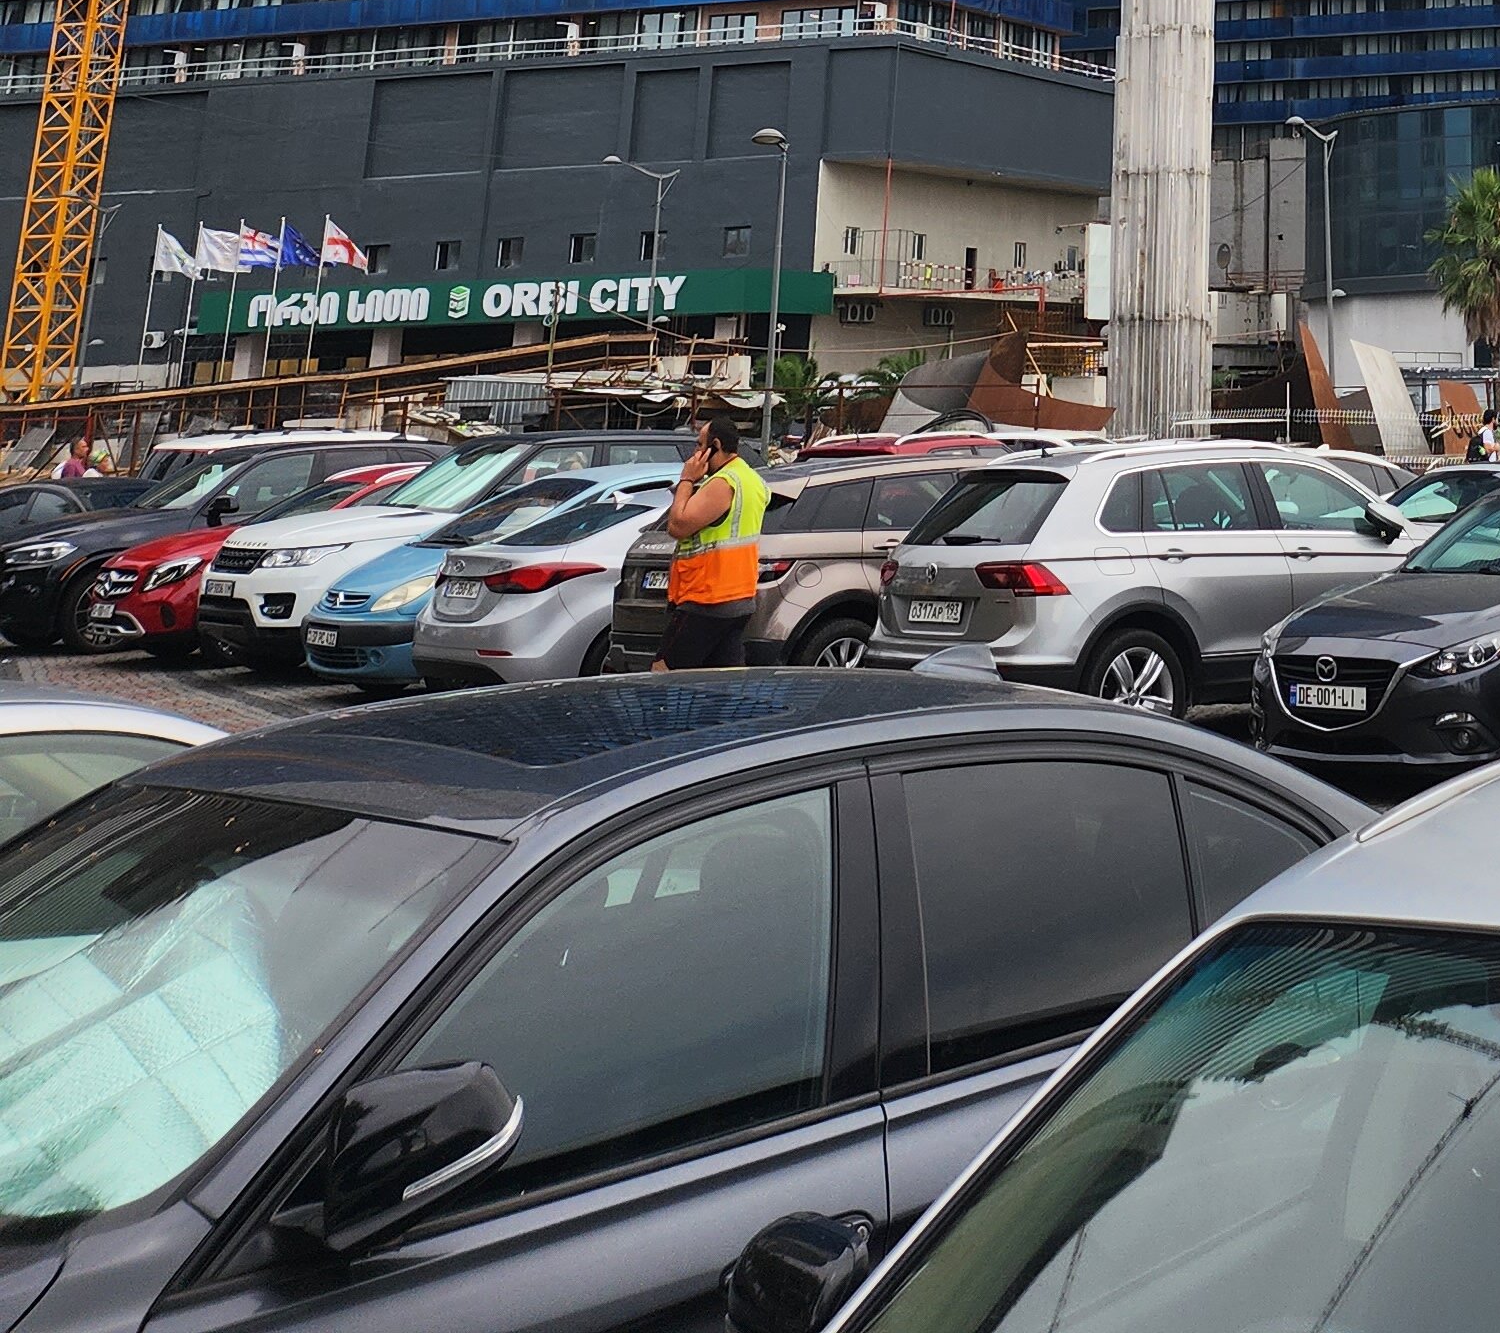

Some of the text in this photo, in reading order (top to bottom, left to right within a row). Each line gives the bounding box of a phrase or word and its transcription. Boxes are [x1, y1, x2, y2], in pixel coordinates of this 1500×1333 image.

[482, 275, 687, 317] ORBI CITY
[1298, 686, 1354, 707] DE-001-LI
